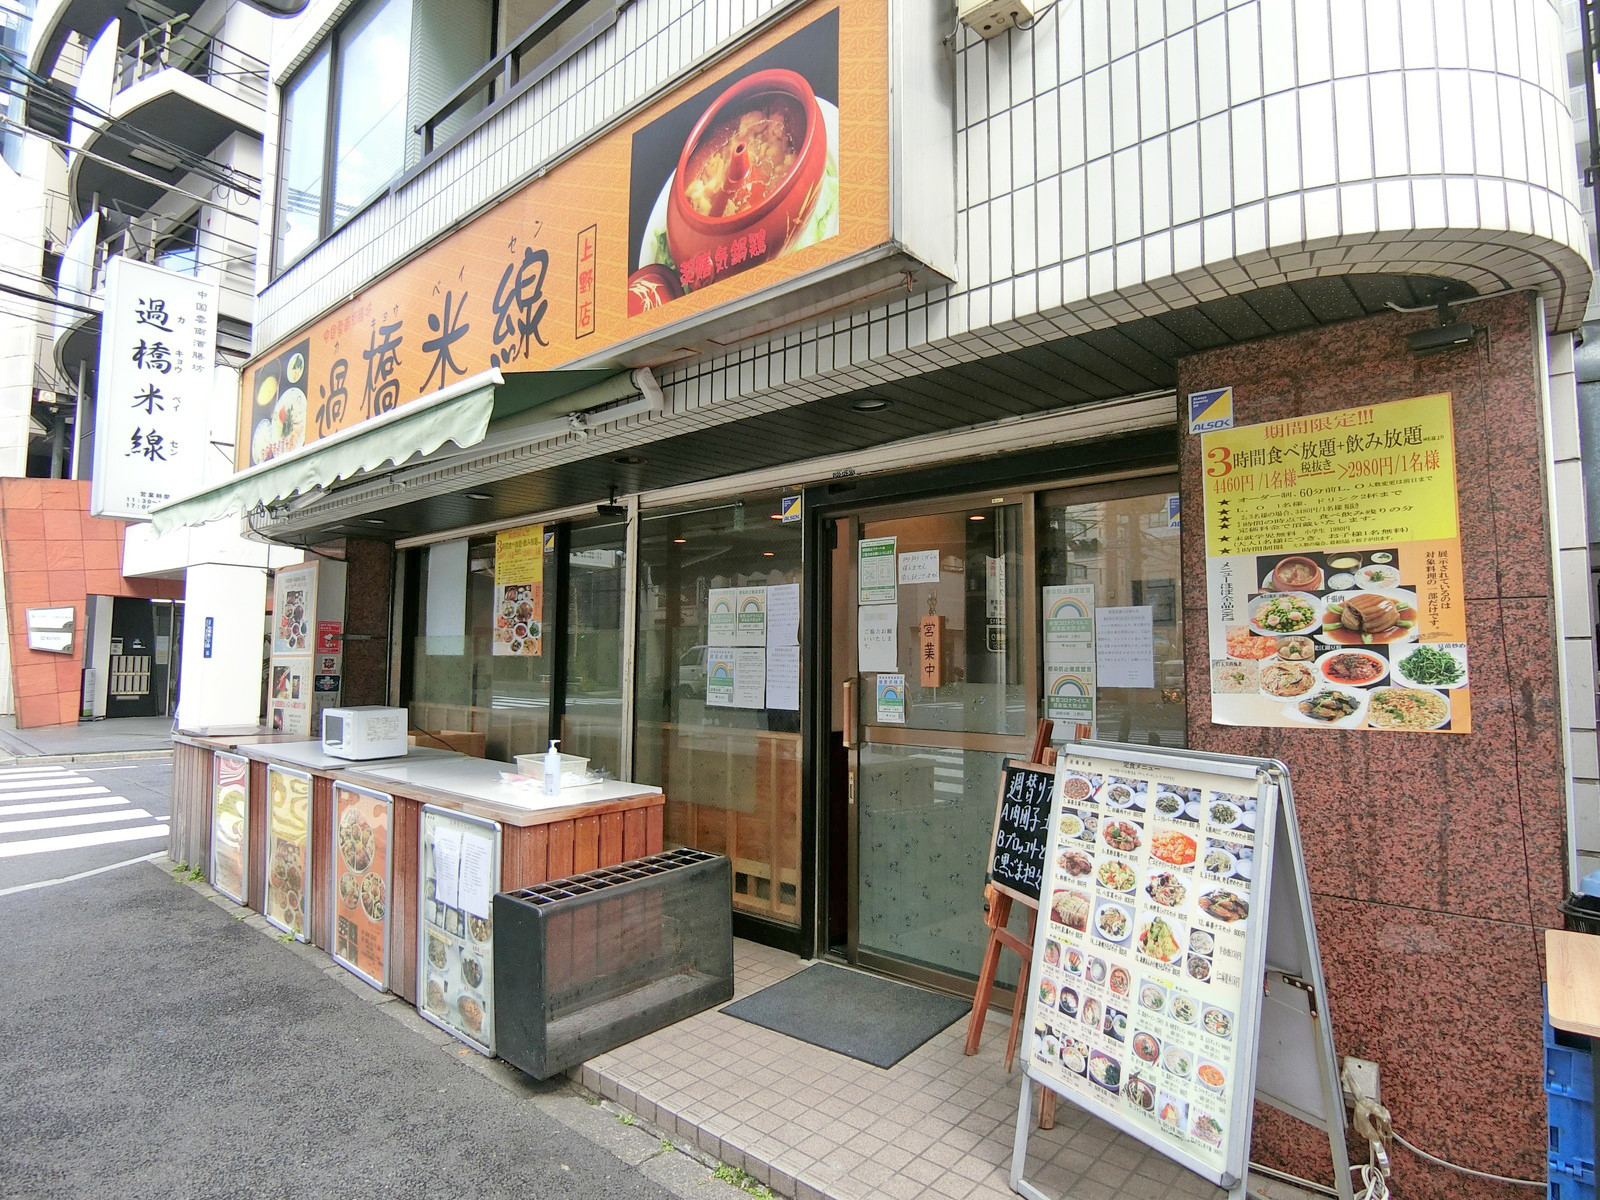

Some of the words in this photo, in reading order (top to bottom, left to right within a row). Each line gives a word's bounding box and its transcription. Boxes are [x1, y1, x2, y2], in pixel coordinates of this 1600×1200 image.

[508, 220, 543, 254] セン
[578, 238, 593, 328] 上野店
[315, 246, 549, 439] 過橋米線
[173, 348, 185, 374] キョウ
[125, 297, 173, 461] 過橋米線
[1192, 419, 1230, 432] ALSOK
[1264, 409, 1374, 440] 期間限定!!!
[170, 440, 179, 457] セン
[1301, 458, 1332, 474] 税抜き
[1214, 474, 1254, 494] 4460円
[1367, 476, 1433, 488] 人数変更は前日まで
[1425, 551, 1440, 630] 対象料理の一部だけです。
[1438, 550, 1451, 609] 展示されているのは
[923, 622, 936, 678] 営業中
[1122, 761, 1161, 772] 定食メニュー
